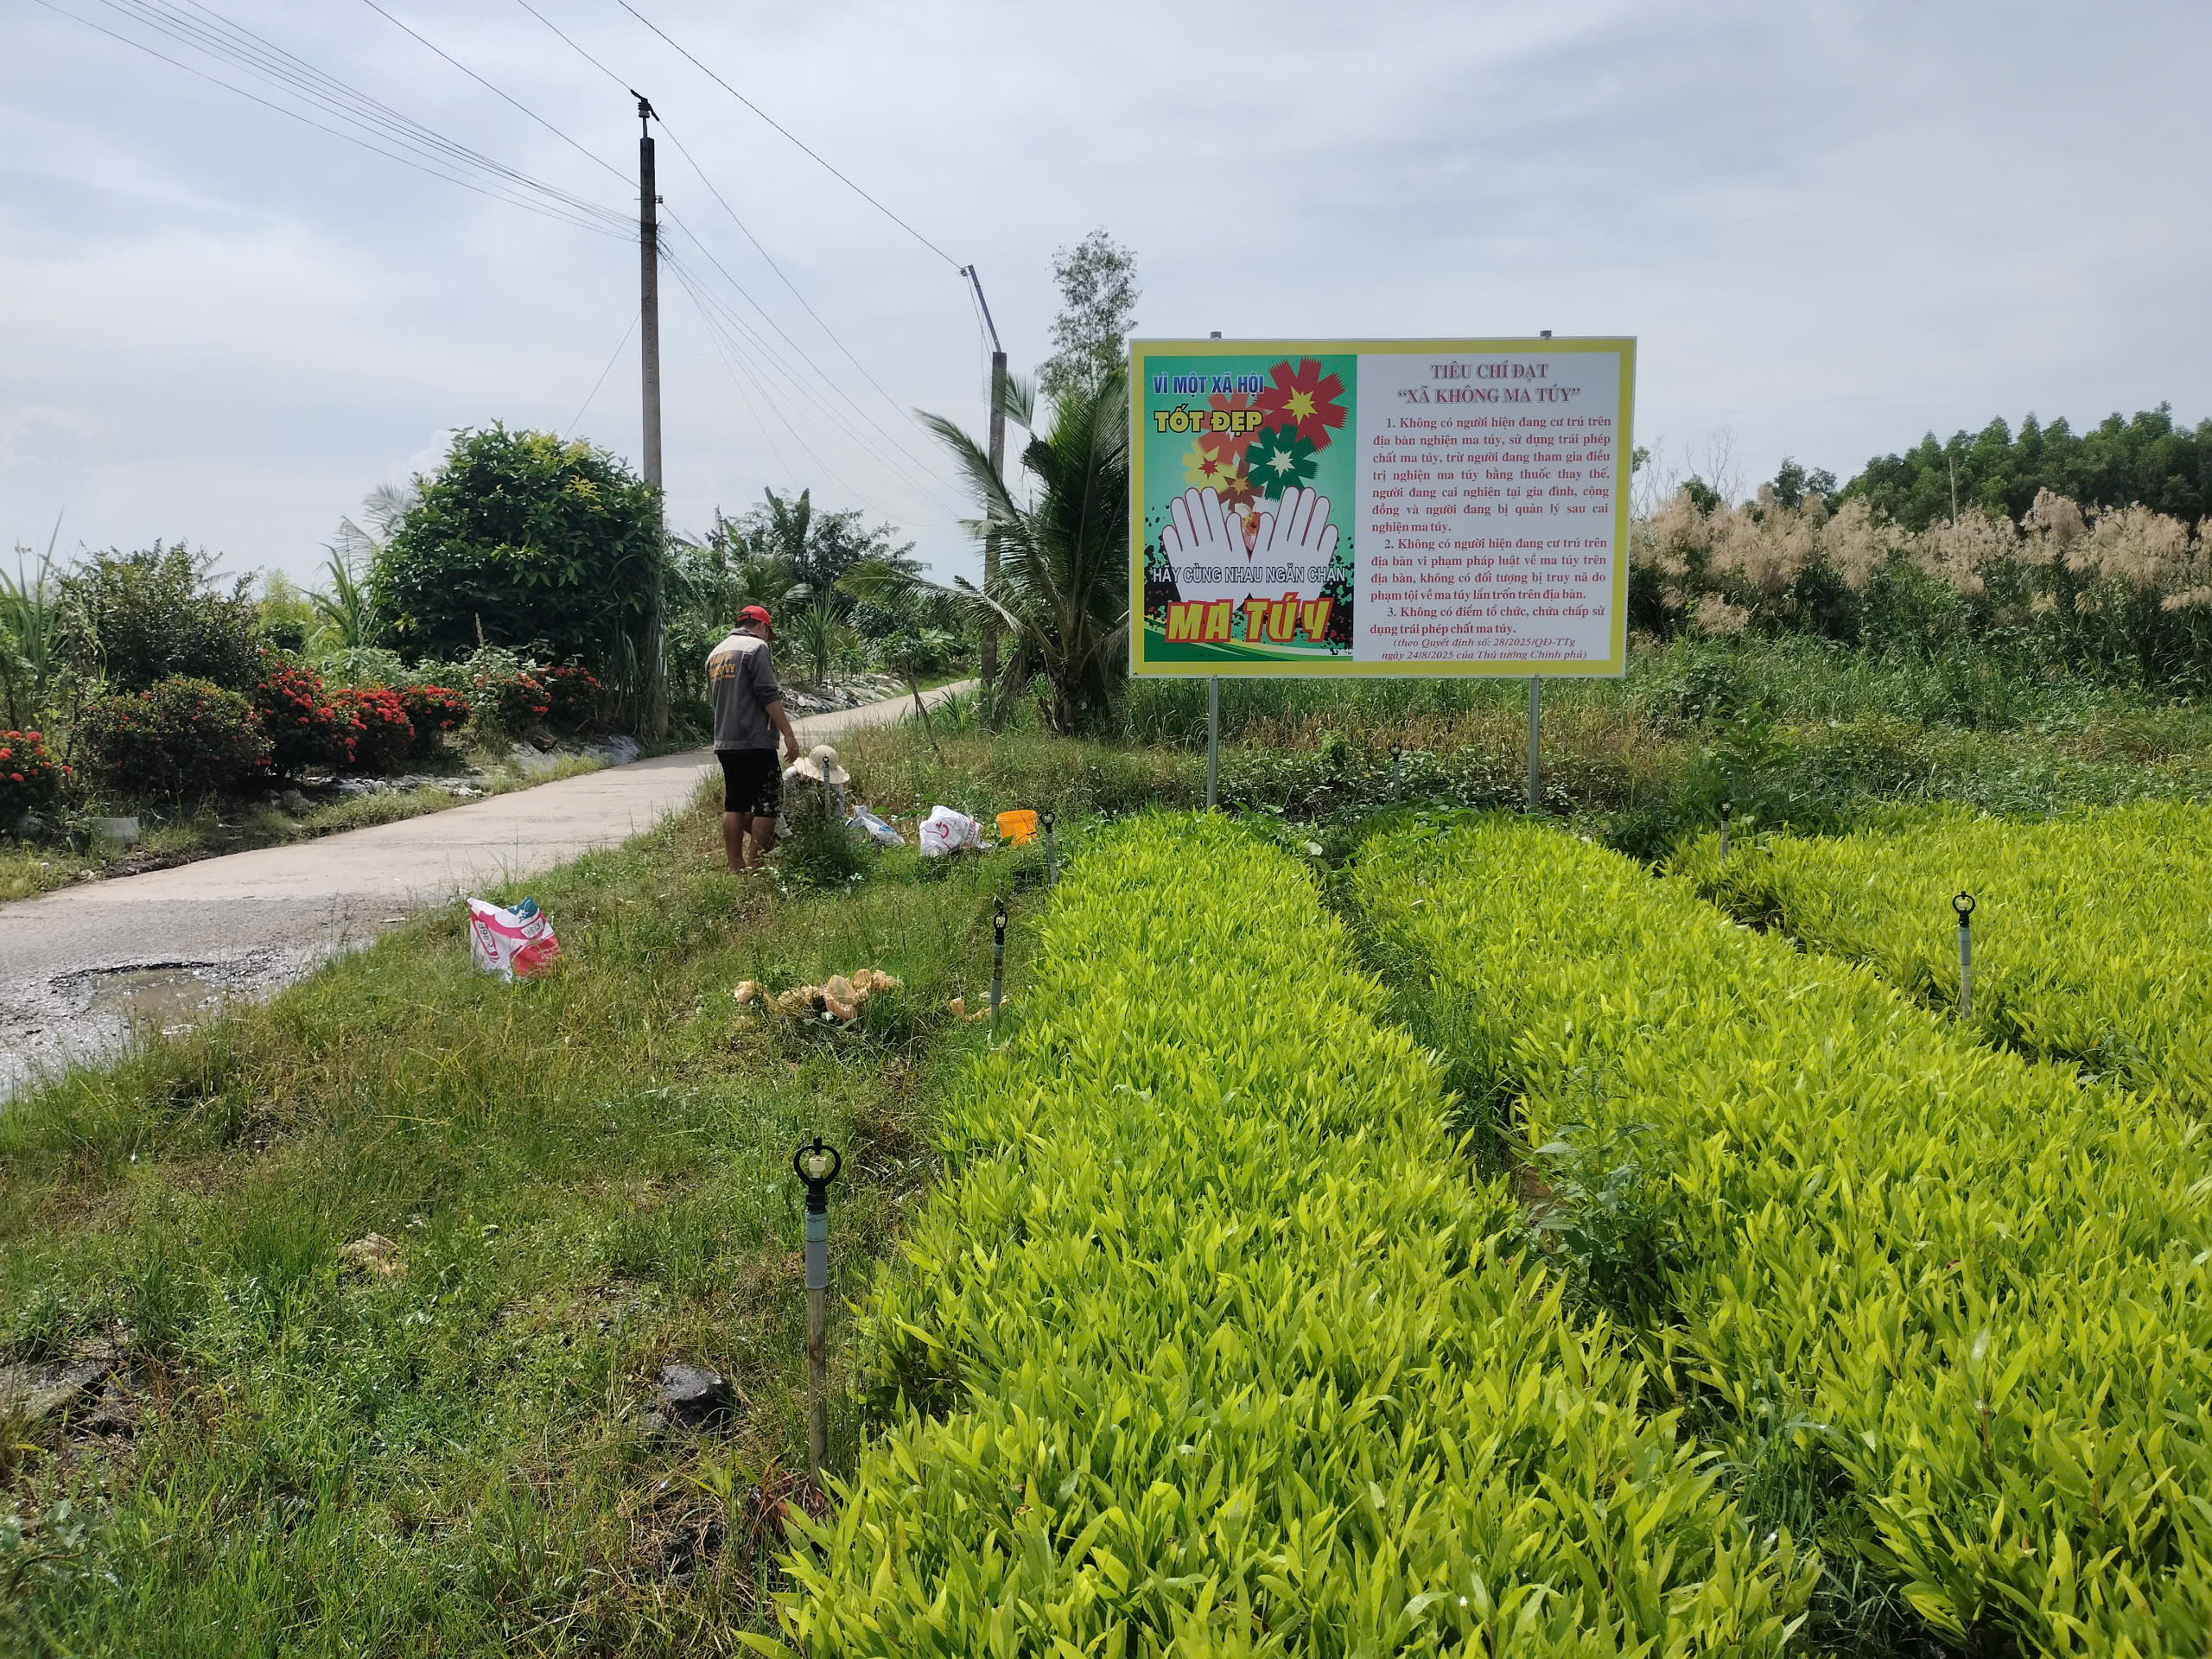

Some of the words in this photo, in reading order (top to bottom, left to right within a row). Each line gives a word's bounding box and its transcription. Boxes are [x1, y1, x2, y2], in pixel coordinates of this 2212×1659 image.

[1431, 360, 1471, 379] TIÊU
[1477, 360, 1508, 379] CHÍ
[1513, 364, 1548, 381] ĐẠT
[1154, 372, 1167, 393] VÌ
[1173, 372, 1207, 397] MỘT
[1211, 373, 1233, 393] XÃ
[1238, 372, 1264, 397] HỘI
[1397, 385, 1430, 404] “XÃ
[1435, 385, 1499, 403] KHÔNG
[1504, 389, 1531, 403] MA
[1535, 385, 1580, 403] TÚY”
[1154, 404, 1205, 433] TỐT
[1211, 410, 1263, 437] ĐẸP
[1387, 417, 1395, 428] 1.
[1400, 416, 1437, 429] Không
[1440, 416, 1452, 427] có
[1456, 416, 1487, 429] người
[1491, 416, 1515, 429] hiện
[1518, 416, 1547, 429] đang
[1567, 416, 1584, 426] trú
[1588, 416, 1611, 426] trên
[1373, 435, 1390, 448] địa
[1395, 435, 1415, 445] bàn
[1420, 435, 1457, 448] nghiện
[1484, 434, 1504, 447] túy,
[1509, 434, 1522, 444] sử
[1525, 435, 1554, 447] dụng
[1558, 434, 1578, 444] trái
[1583, 434, 1610, 447] phép
[1372, 450, 1396, 462] chất
[1421, 452, 1442, 465] túy,
[1446, 452, 1464, 462] trừ
[1466, 452, 1497, 465] người
[1502, 452, 1529, 464] đang
[1533, 452, 1561, 461] tham
[1565, 451, 1582, 464] gia
[1586, 449, 1610, 461] điều
[1373, 470, 1386, 482] trị
[1393, 469, 1430, 482] nghiện
[1461, 469, 1478, 482] túy
[1485, 467, 1513, 481] bằng
[1520, 467, 1550, 479] thuốc
[1557, 468, 1582, 481] thay
[1589, 467, 1609, 480] thế,
[1372, 486, 1402, 499] người
[1408, 487, 1436, 499] đang
[1441, 486, 1457, 497] cai
[1463, 486, 1500, 499] nghiện
[1506, 486, 1520, 499] tại
[1526, 486, 1542, 499] gia
[1548, 486, 1577, 498] đình,
[1582, 486, 1609, 499] cộng
[1372, 502, 1399, 517] đồng
[1406, 504, 1418, 514] và
[1426, 504, 1456, 517] người
[1463, 504, 1491, 516] đang
[1497, 504, 1508, 516] bị
[1515, 503, 1542, 516] quản
[1550, 503, 1559, 516] lý
[1592, 503, 1607, 513] cai
[1371, 521, 1408, 534] nghiện
[1430, 521, 1451, 534] túy.
[1384, 538, 1394, 549] 2.
[1397, 538, 1435, 551] Không
[1438, 538, 1450, 549] có
[1453, 537, 1484, 550] người
[1488, 537, 1511, 550] hiện
[1515, 538, 1543, 550] đang
[1563, 537, 1580, 548] trú
[1584, 537, 1606, 548] trên
[1370, 556, 1388, 568] địa
[1392, 556, 1413, 566] bàn
[1417, 556, 1427, 566] vi
[1431, 556, 1462, 568] phạm
[1466, 555, 1494, 568] pháp
[1498, 555, 1520, 567] luật
[1523, 553, 1535, 565] về
[1561, 554, 1579, 567] túy
[1583, 554, 1605, 564] trên
[1183, 563, 1222, 583] CÙNG
[1225, 567, 1262, 582] NHAU
[1265, 563, 1305, 582] NGĂN
[1370, 573, 1388, 585] địa
[1392, 572, 1415, 584] bàn,
[1420, 572, 1454, 585] không
[1458, 572, 1471, 582] có
[1474, 570, 1491, 582] đối
[1496, 573, 1528, 585] tượng
[1531, 572, 1541, 584] bị
[1547, 573, 1570, 584] truy
[1574, 571, 1587, 582] nã
[1592, 572, 1605, 582] do
[1370, 590, 1402, 602] phạm
[1403, 589, 1418, 602] tội
[1420, 588, 1432, 600] về
[1453, 589, 1471, 602] túy
[1492, 587, 1516, 600] trốn
[1517, 588, 1541, 600] trên
[1542, 589, 1560, 601] địa
[1561, 588, 1586, 599] bàn.
[1165, 599, 1234, 643] MA
[1244, 592, 1334, 642] TÚY
[1388, 607, 1395, 617] 3.
[1401, 607, 1436, 620] Không
[1440, 606, 1452, 617] có
[1455, 604, 1482, 616] điểm
[1486, 604, 1497, 616] tổ
[1500, 606, 1529, 618] chức,
[1532, 606, 1558, 616] chứa
[1562, 604, 1588, 619] chấp
[1592, 605, 1604, 616] sử
[1370, 624, 1397, 637] dụng
[1400, 623, 1419, 634] trái
[1421, 623, 1448, 636] phép
[1450, 621, 1473, 633] chất
[1495, 623, 1516, 636] túy.
